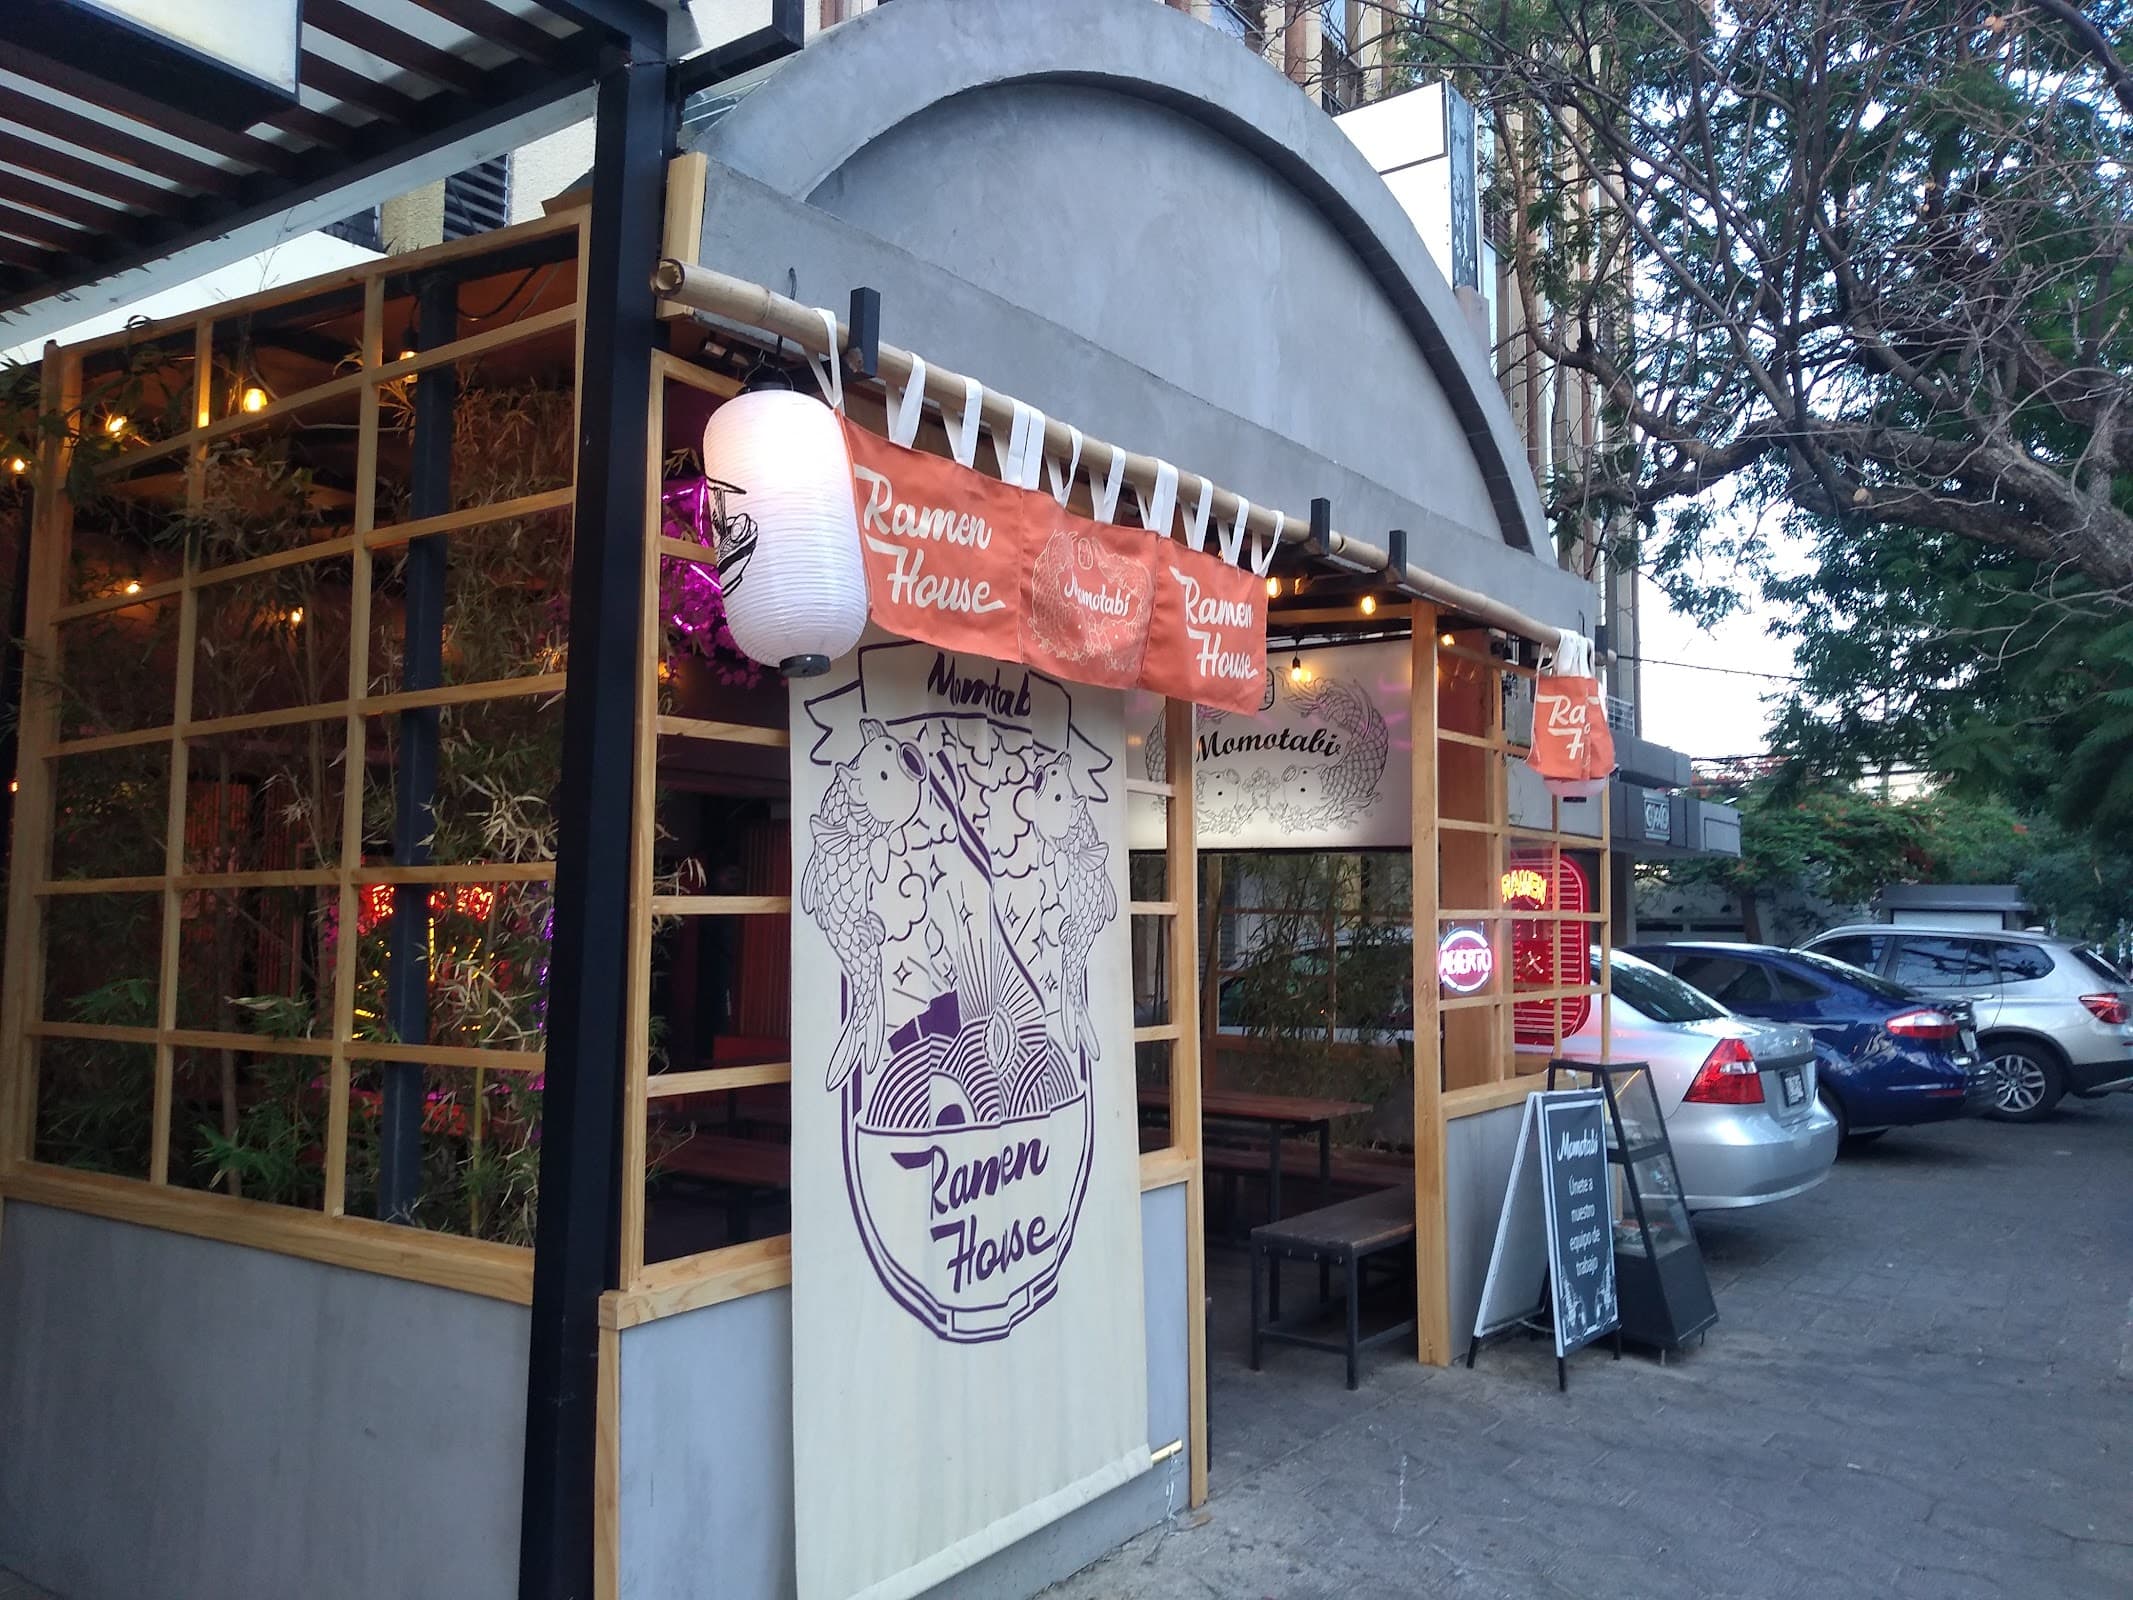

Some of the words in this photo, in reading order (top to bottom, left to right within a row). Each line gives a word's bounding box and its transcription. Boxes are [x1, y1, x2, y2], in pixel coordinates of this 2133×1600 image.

[854, 464, 993, 550] Ramen
[864, 533, 1007, 614] House
[1168, 565, 1254, 629] Ramen
[1186, 624, 1259, 680] House
[1195, 728, 1341, 763] Momotabi
[1501, 869, 1547, 906] RAMEN
[1440, 948, 1492, 975] ABIERTO
